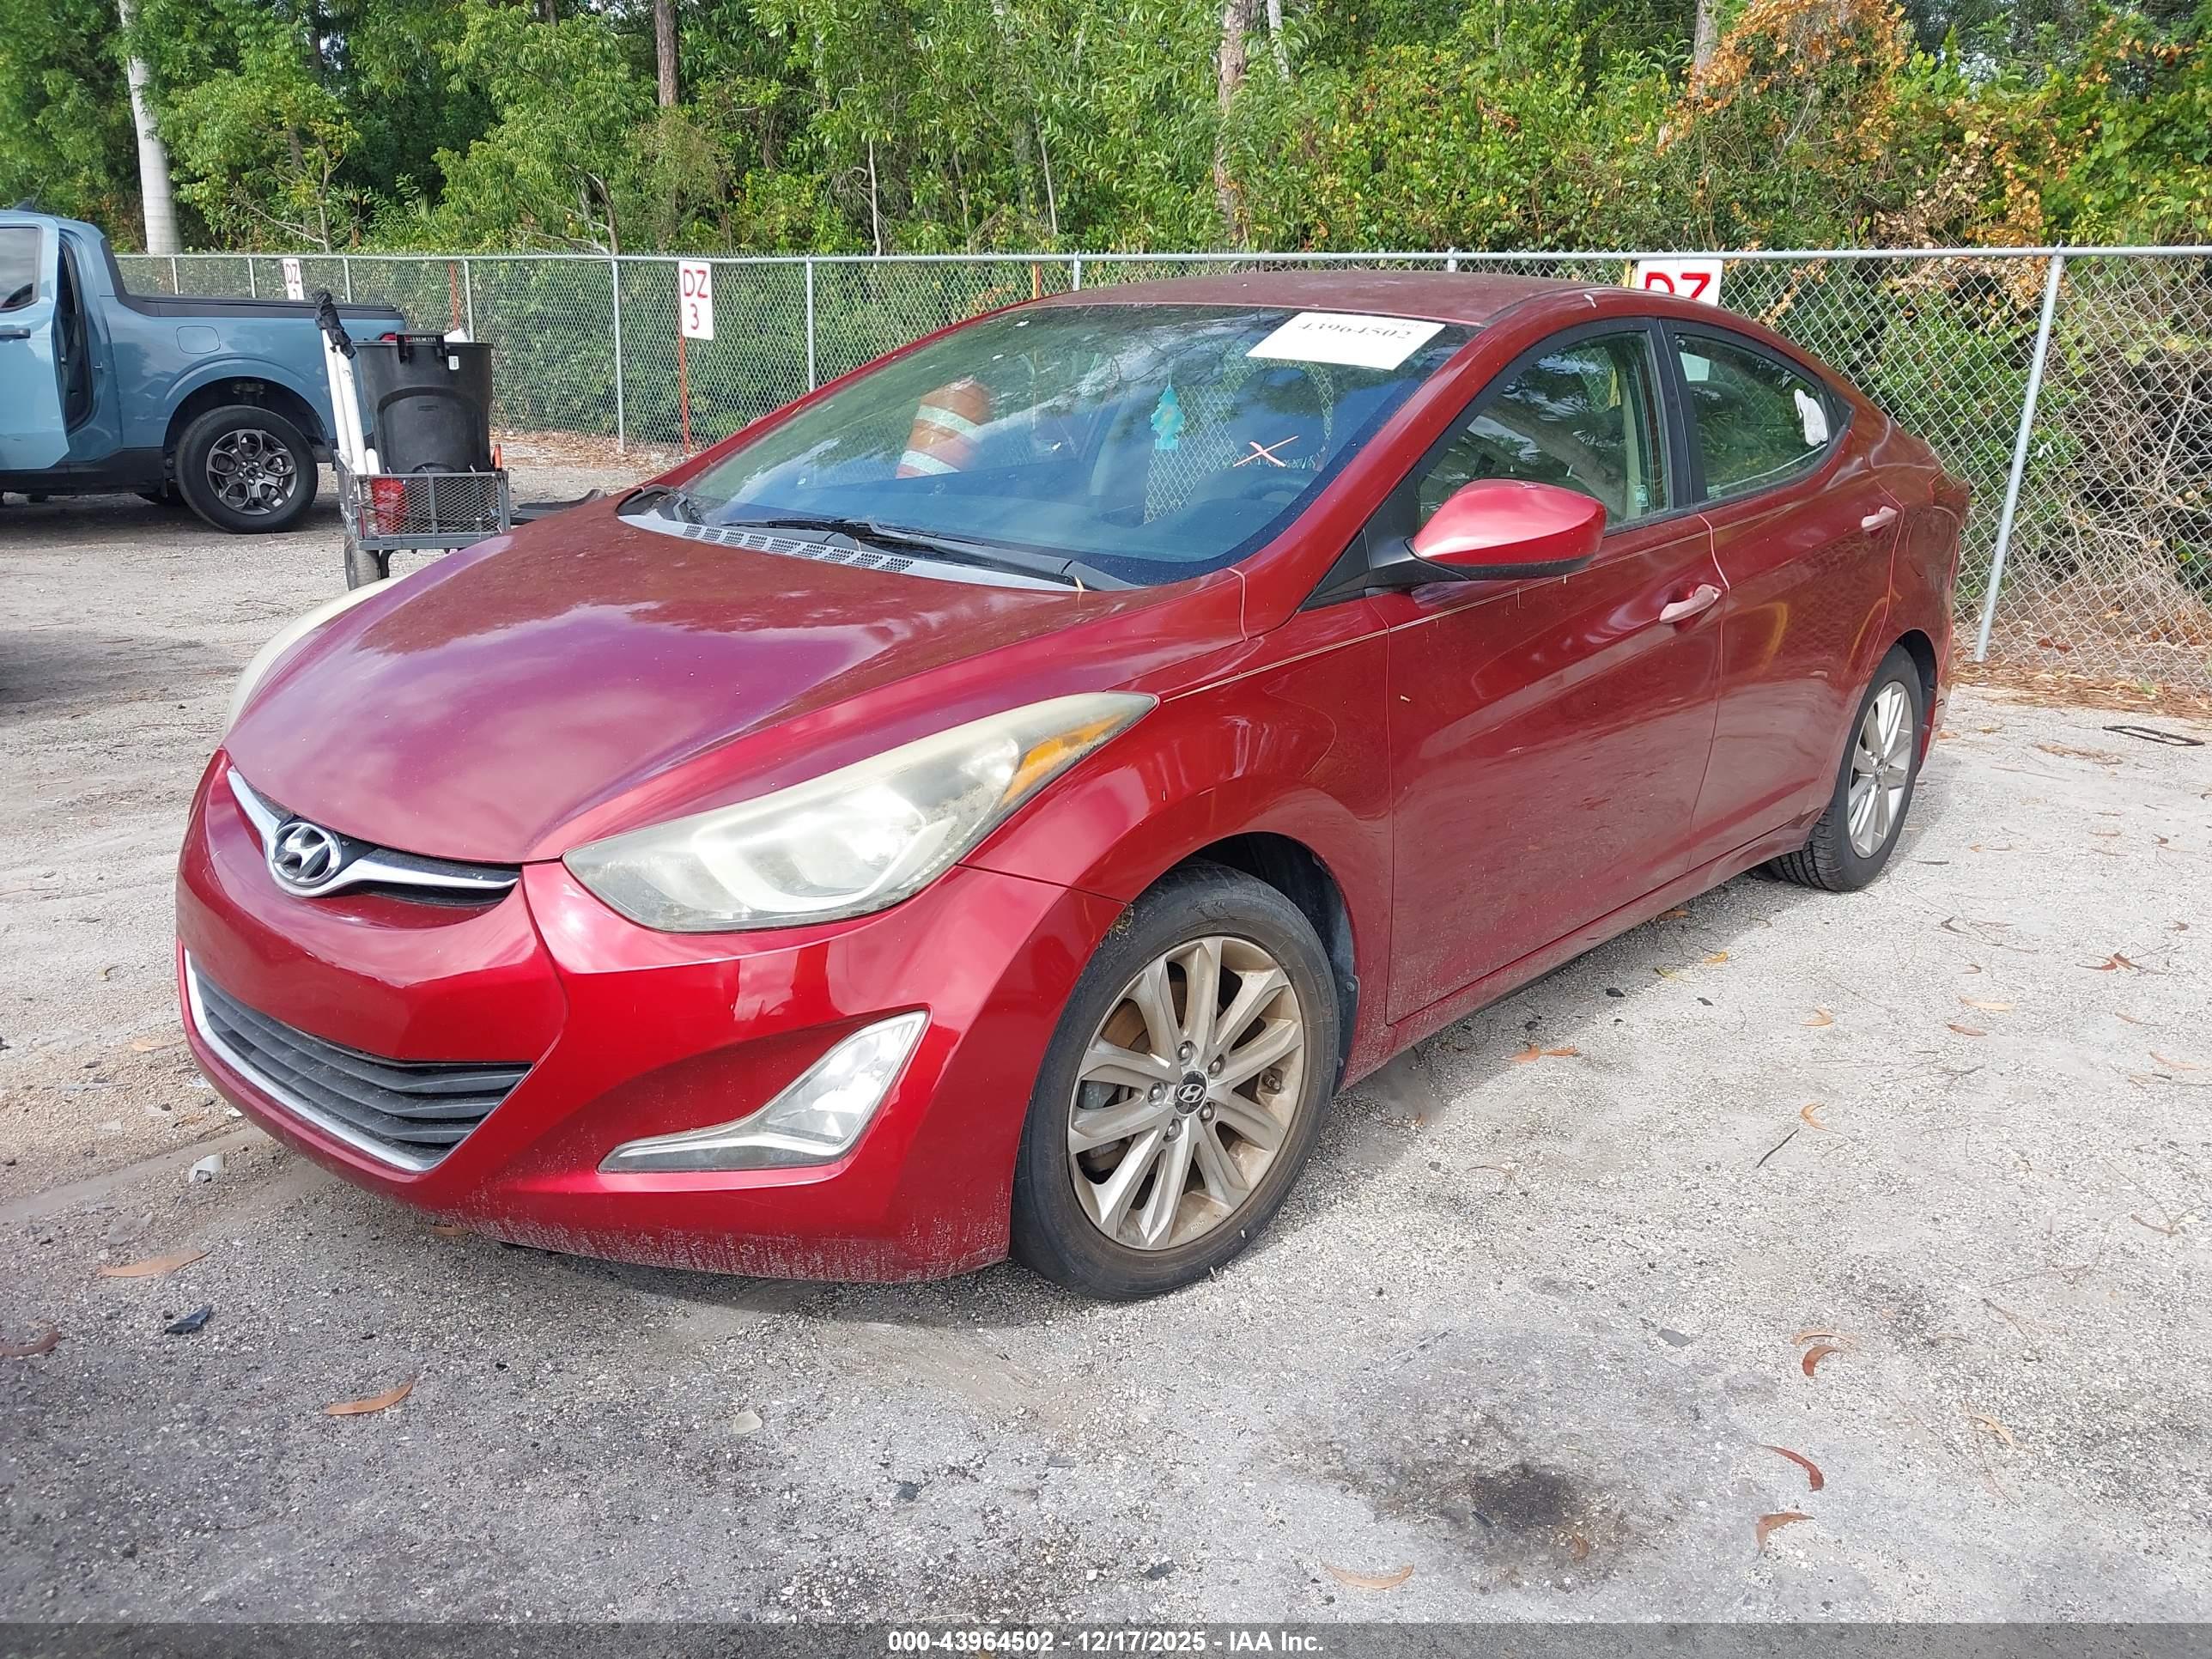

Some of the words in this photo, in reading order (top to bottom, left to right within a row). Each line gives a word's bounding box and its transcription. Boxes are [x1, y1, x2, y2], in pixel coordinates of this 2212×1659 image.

[285, 263, 300, 284] DZ
[684, 269, 708, 298] DZ
[690, 303, 699, 330] 3
